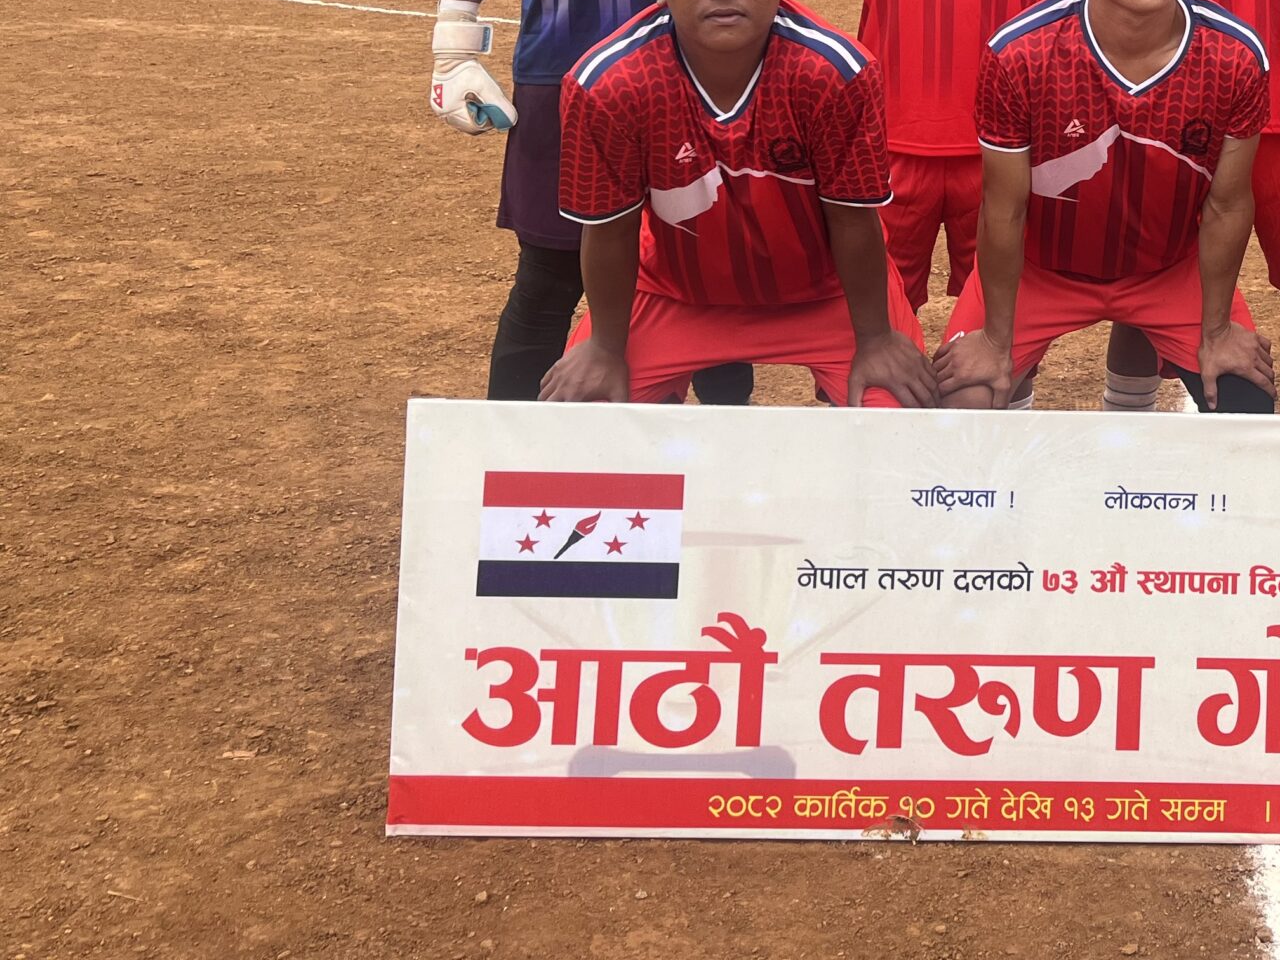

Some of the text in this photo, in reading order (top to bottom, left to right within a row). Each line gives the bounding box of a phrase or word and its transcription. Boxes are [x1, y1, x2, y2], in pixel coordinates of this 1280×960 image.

[911, 486, 996, 512] राष्ट्रियता
[1105, 486, 1199, 511] लोकतन्त्र
[797, 559, 869, 590] नेपाल
[878, 568, 944, 591] तरुण
[953, 561, 1034, 593] दलको
[1042, 569, 1079, 594] ७३
[1090, 562, 1128, 593] औं
[1136, 571, 1241, 595] स्थापना
[461, 612, 779, 749] आठौं
[708, 795, 782, 819] २०८२
[793, 786, 893, 819] कार्तिक
[899, 795, 935, 819] १०
[945, 788, 991, 819] गते
[1000, 789, 1054, 822] देखि
[1063, 796, 1095, 822] १३
[1105, 790, 1150, 821] गते
[1160, 798, 1228, 822] सम्म
